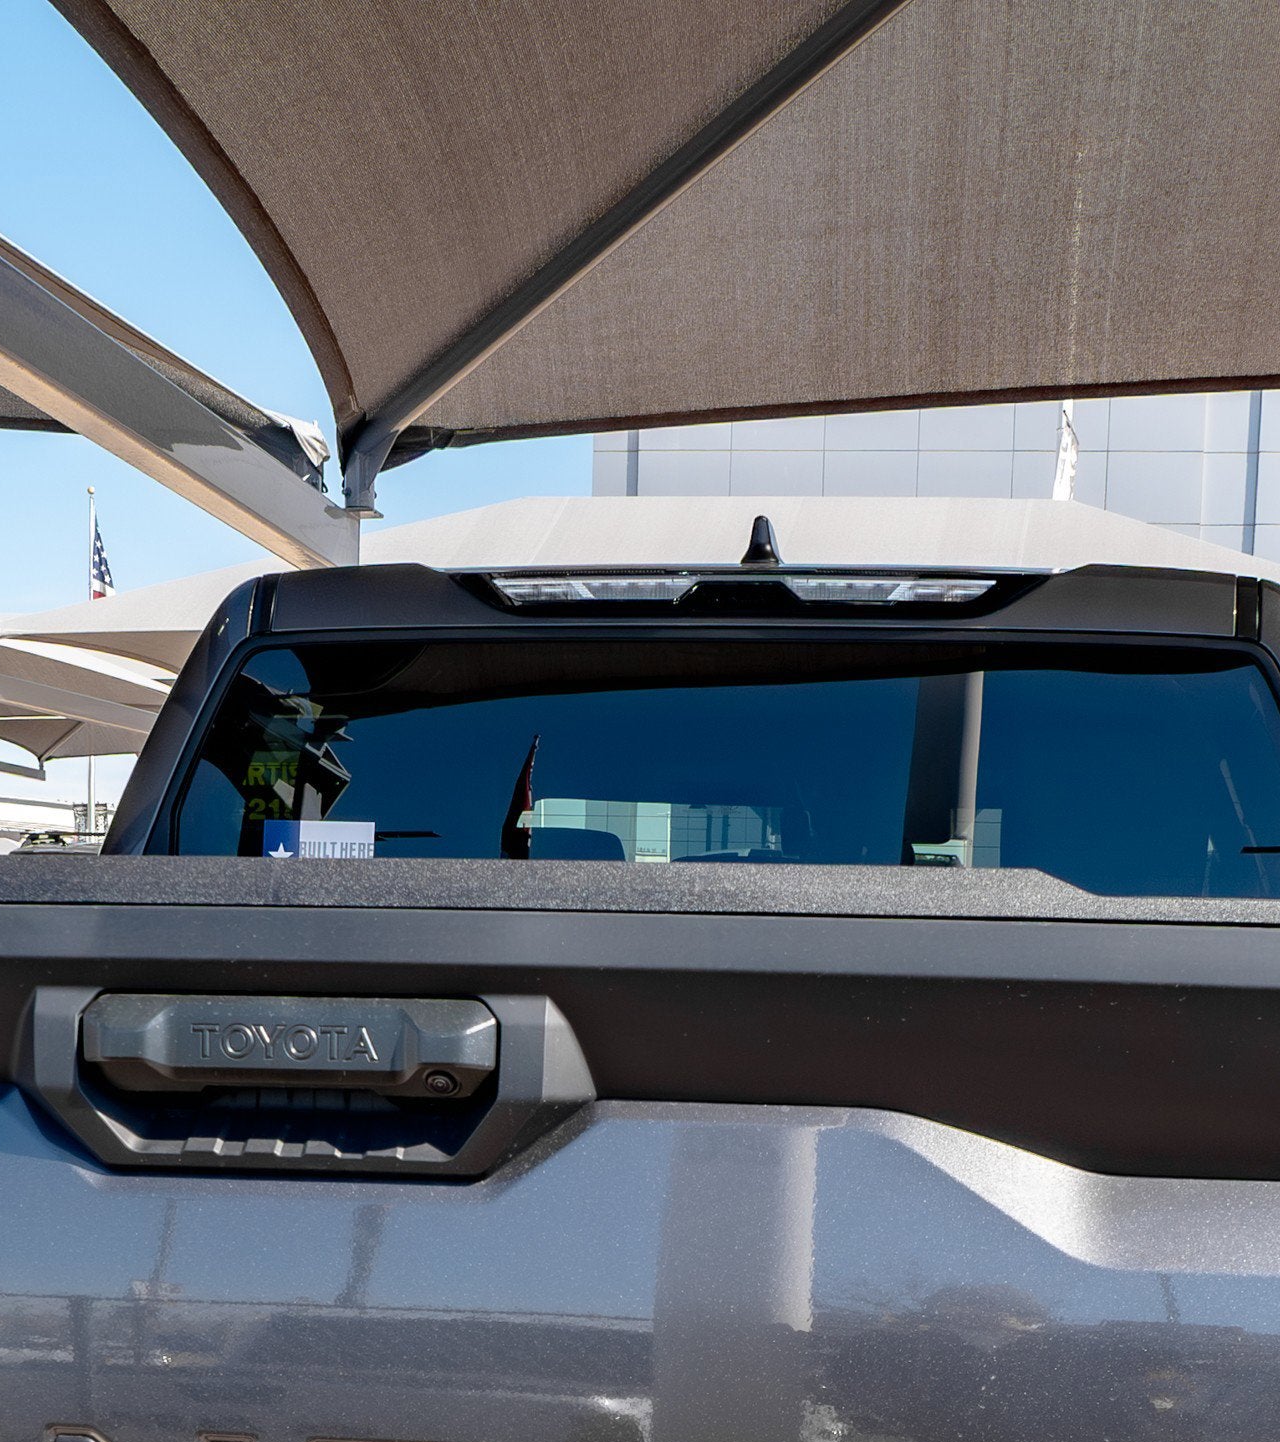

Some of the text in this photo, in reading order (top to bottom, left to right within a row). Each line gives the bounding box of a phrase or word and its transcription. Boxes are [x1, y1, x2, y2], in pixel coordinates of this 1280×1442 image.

[299, 841, 375, 859] BUILT HERE
[192, 1022, 380, 1062] TOYOTA
